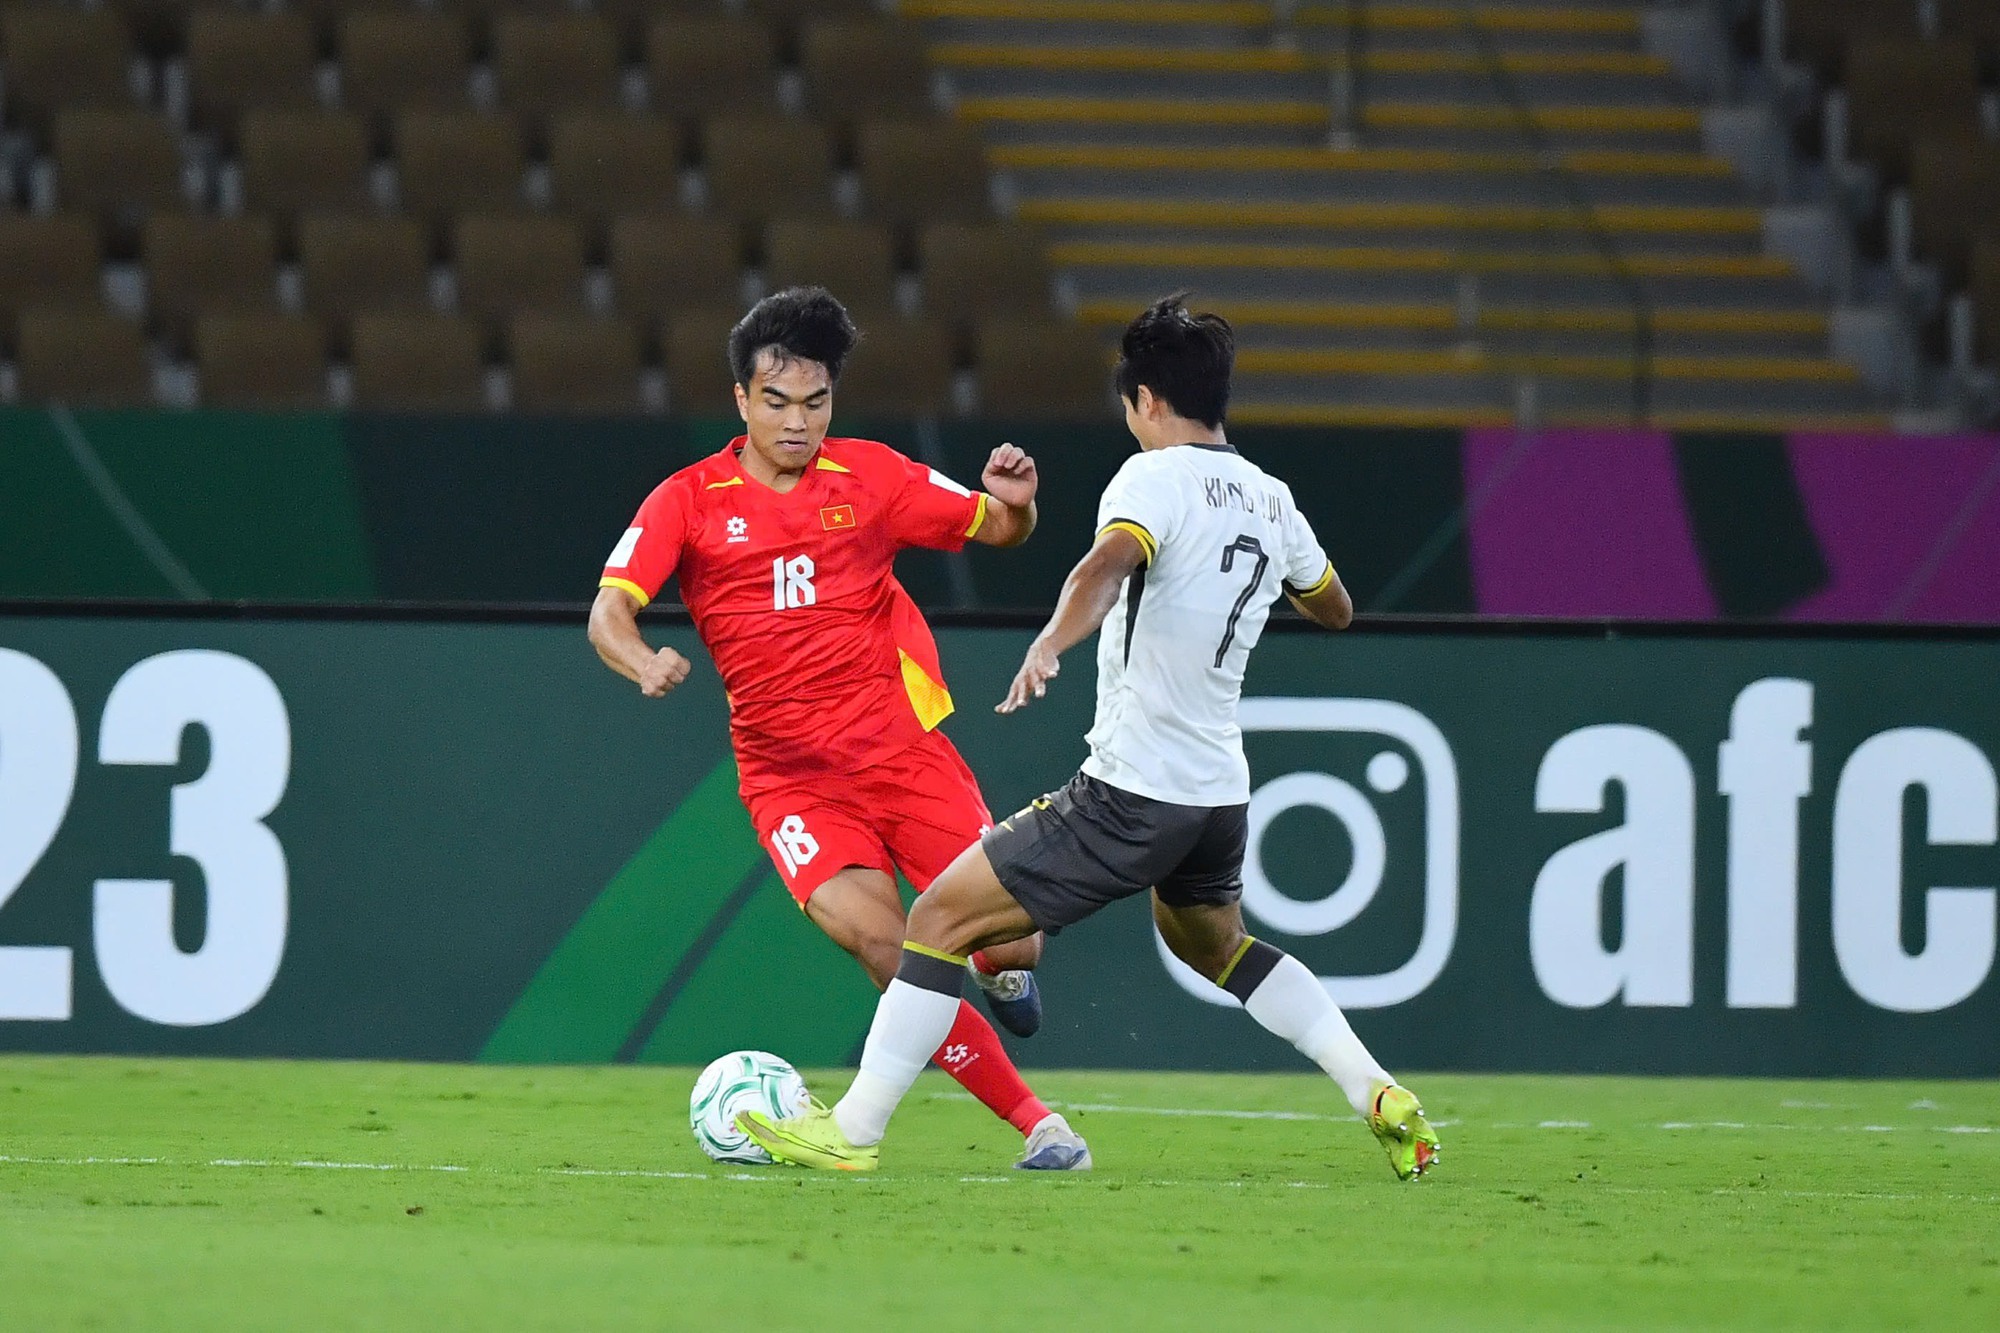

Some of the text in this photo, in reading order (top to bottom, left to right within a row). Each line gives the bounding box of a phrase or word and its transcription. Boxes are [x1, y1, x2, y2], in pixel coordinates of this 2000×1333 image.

[773, 554, 816, 610] 18
[1213, 534, 1269, 668] 7
[771, 815, 820, 878] 18
[1529, 677, 1997, 1013] afc
